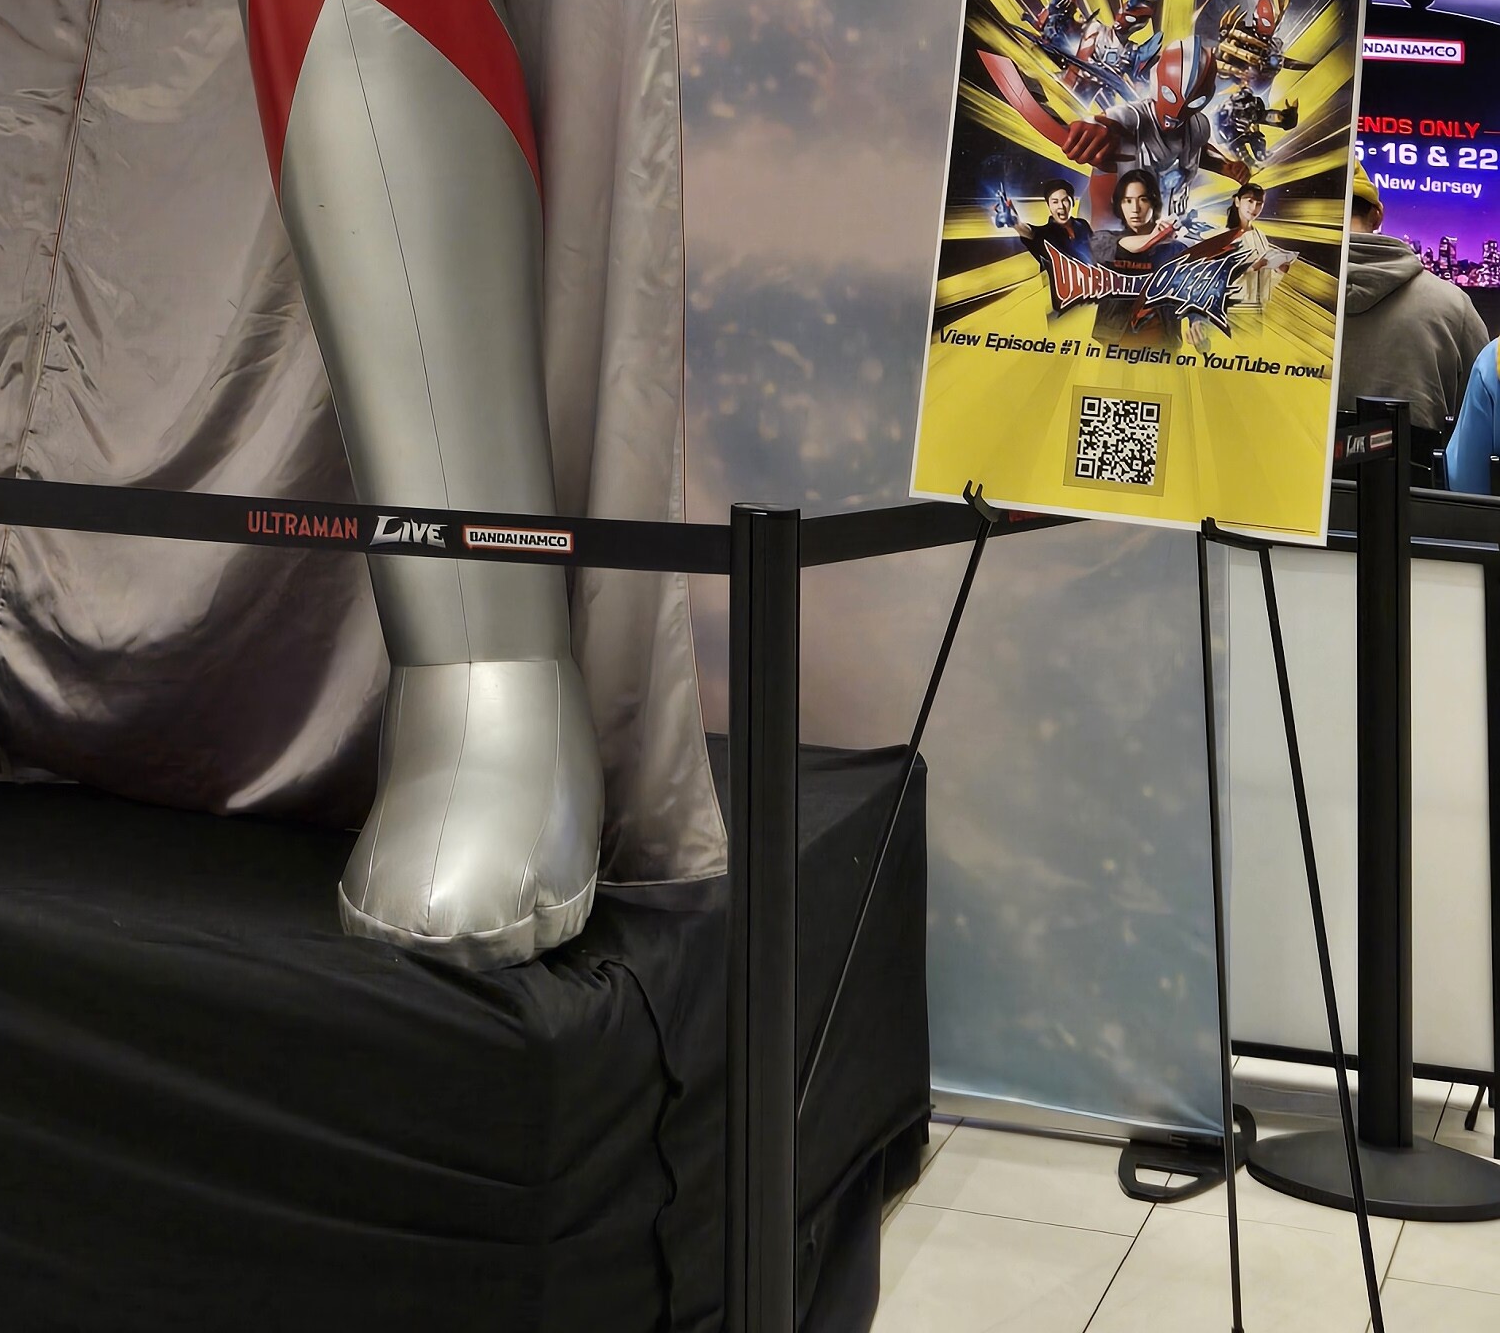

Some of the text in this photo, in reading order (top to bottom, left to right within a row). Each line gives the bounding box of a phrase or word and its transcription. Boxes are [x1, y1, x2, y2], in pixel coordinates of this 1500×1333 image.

[1400, 43, 1457, 58] NAMCO
[1420, 119, 1480, 139] ONLY
[1427, 146, 1450, 167] &
[1374, 173, 1482, 198] New Jersey
[1043, 239, 1257, 327] ULTRAMAN OMEGA
[939, 328, 1325, 378] View Episode #1 in English on YouTube now!
[247, 510, 568, 549] ULTRAMAN LIVE BANDAI NAMCO
